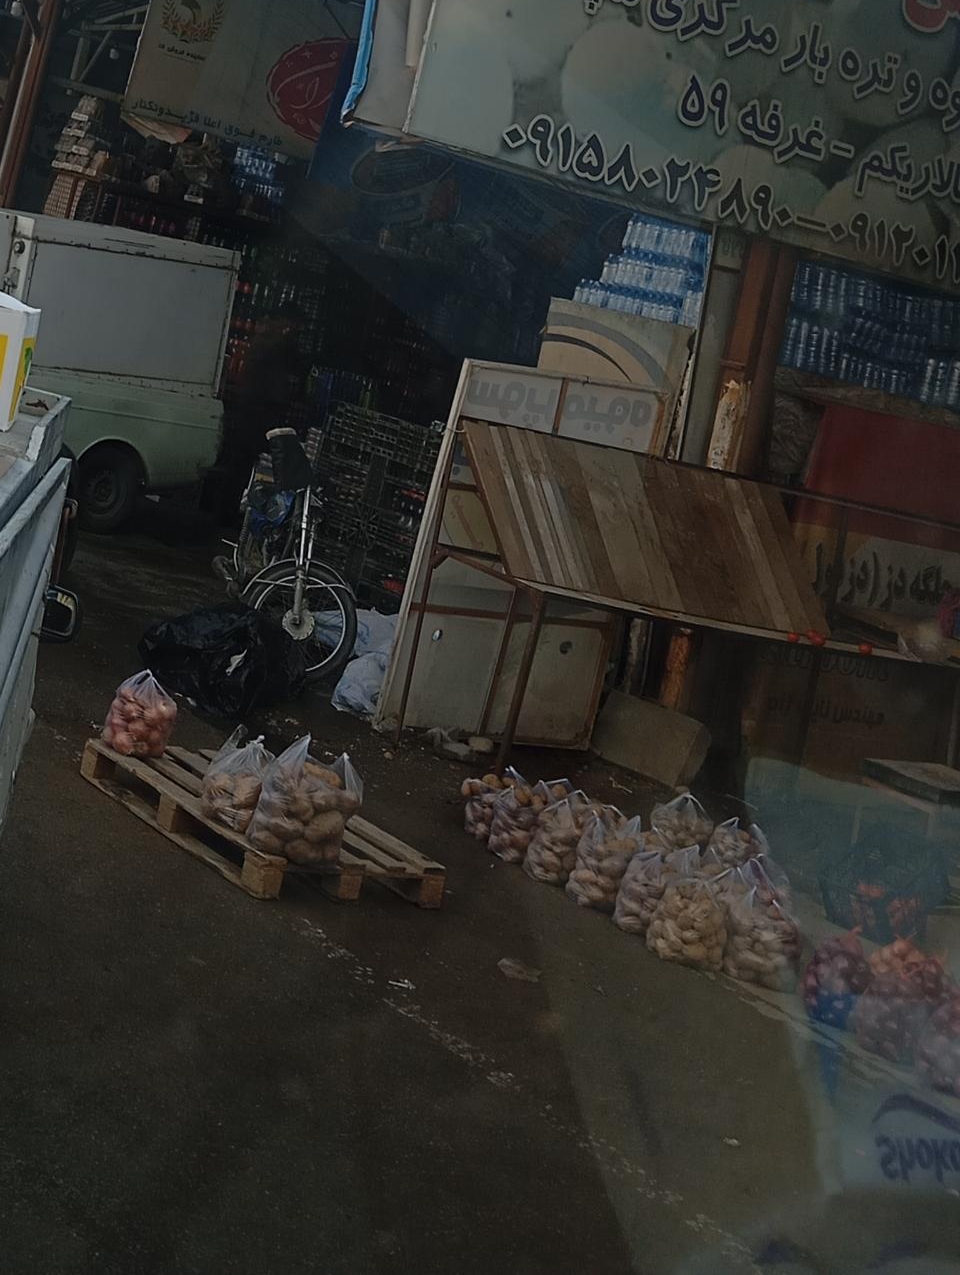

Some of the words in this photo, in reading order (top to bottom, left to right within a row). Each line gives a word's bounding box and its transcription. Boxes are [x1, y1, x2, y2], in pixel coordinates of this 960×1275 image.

[780, 21, 832, 86] بار
[839, 48, 901, 101] تره
[678, 72, 730, 134] ۵۹
[895, 70, 924, 116] و
[738, 97, 827, 165] غرفه
